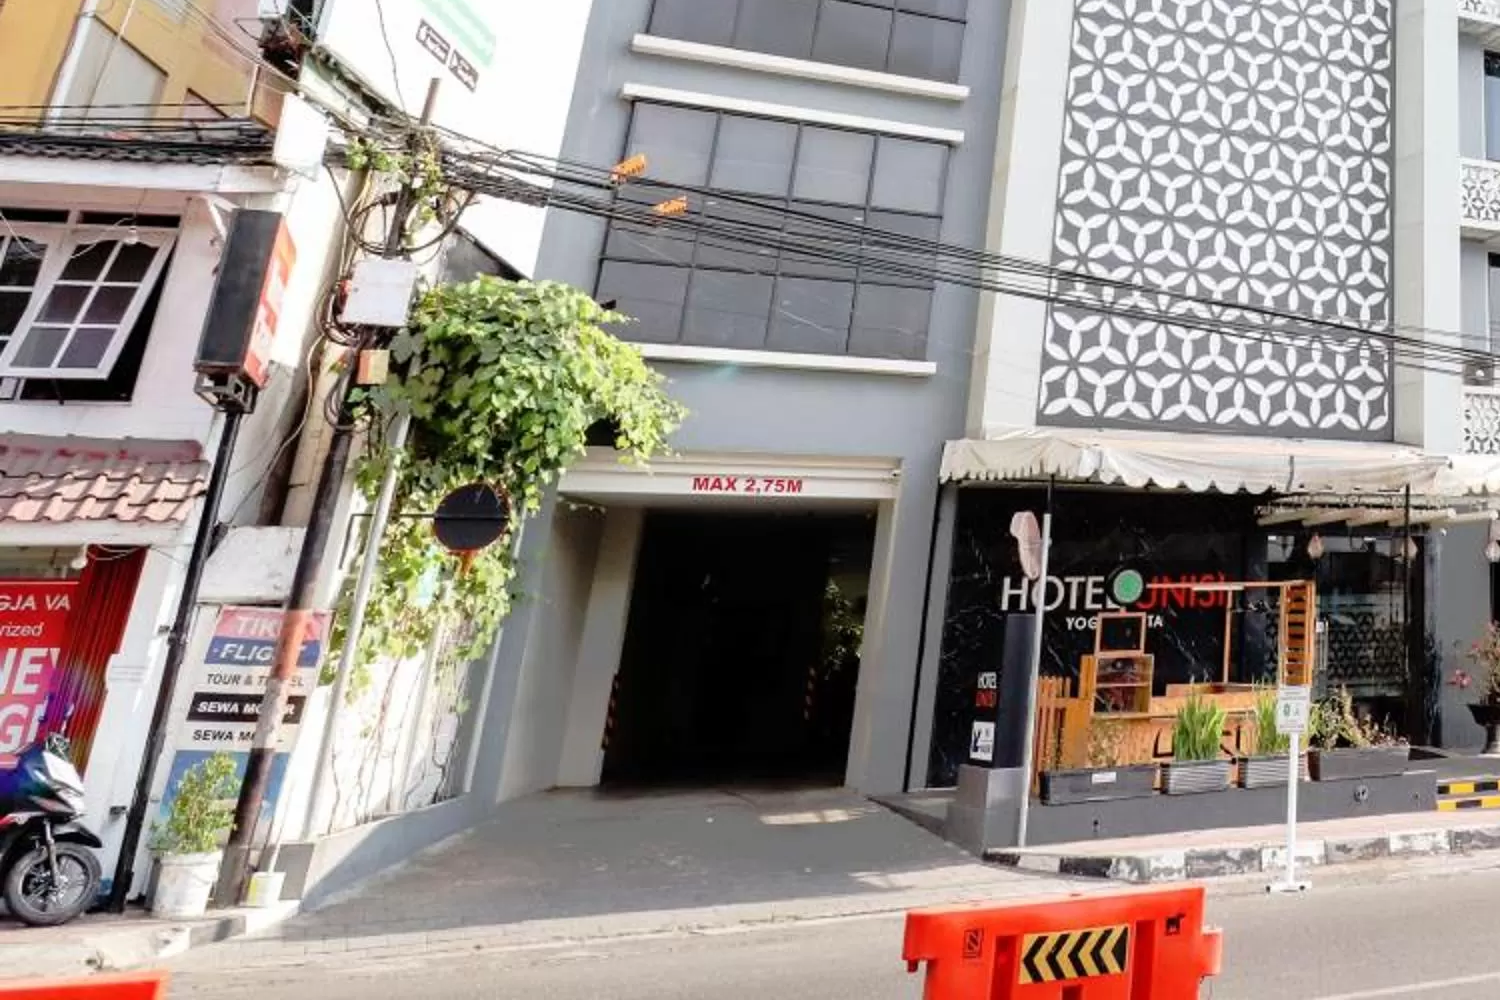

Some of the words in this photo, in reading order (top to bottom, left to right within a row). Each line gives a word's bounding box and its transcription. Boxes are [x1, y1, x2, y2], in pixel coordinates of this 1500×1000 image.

[692, 477, 738, 491] MAX
[744, 477, 803, 493] 2,75M
[44, 594, 71, 611] VA
[219, 643, 307, 661] FLIG
[207, 673, 241, 685] TOUR
[197, 701, 240, 714] SEWA
[193, 729, 234, 741] SEWA
